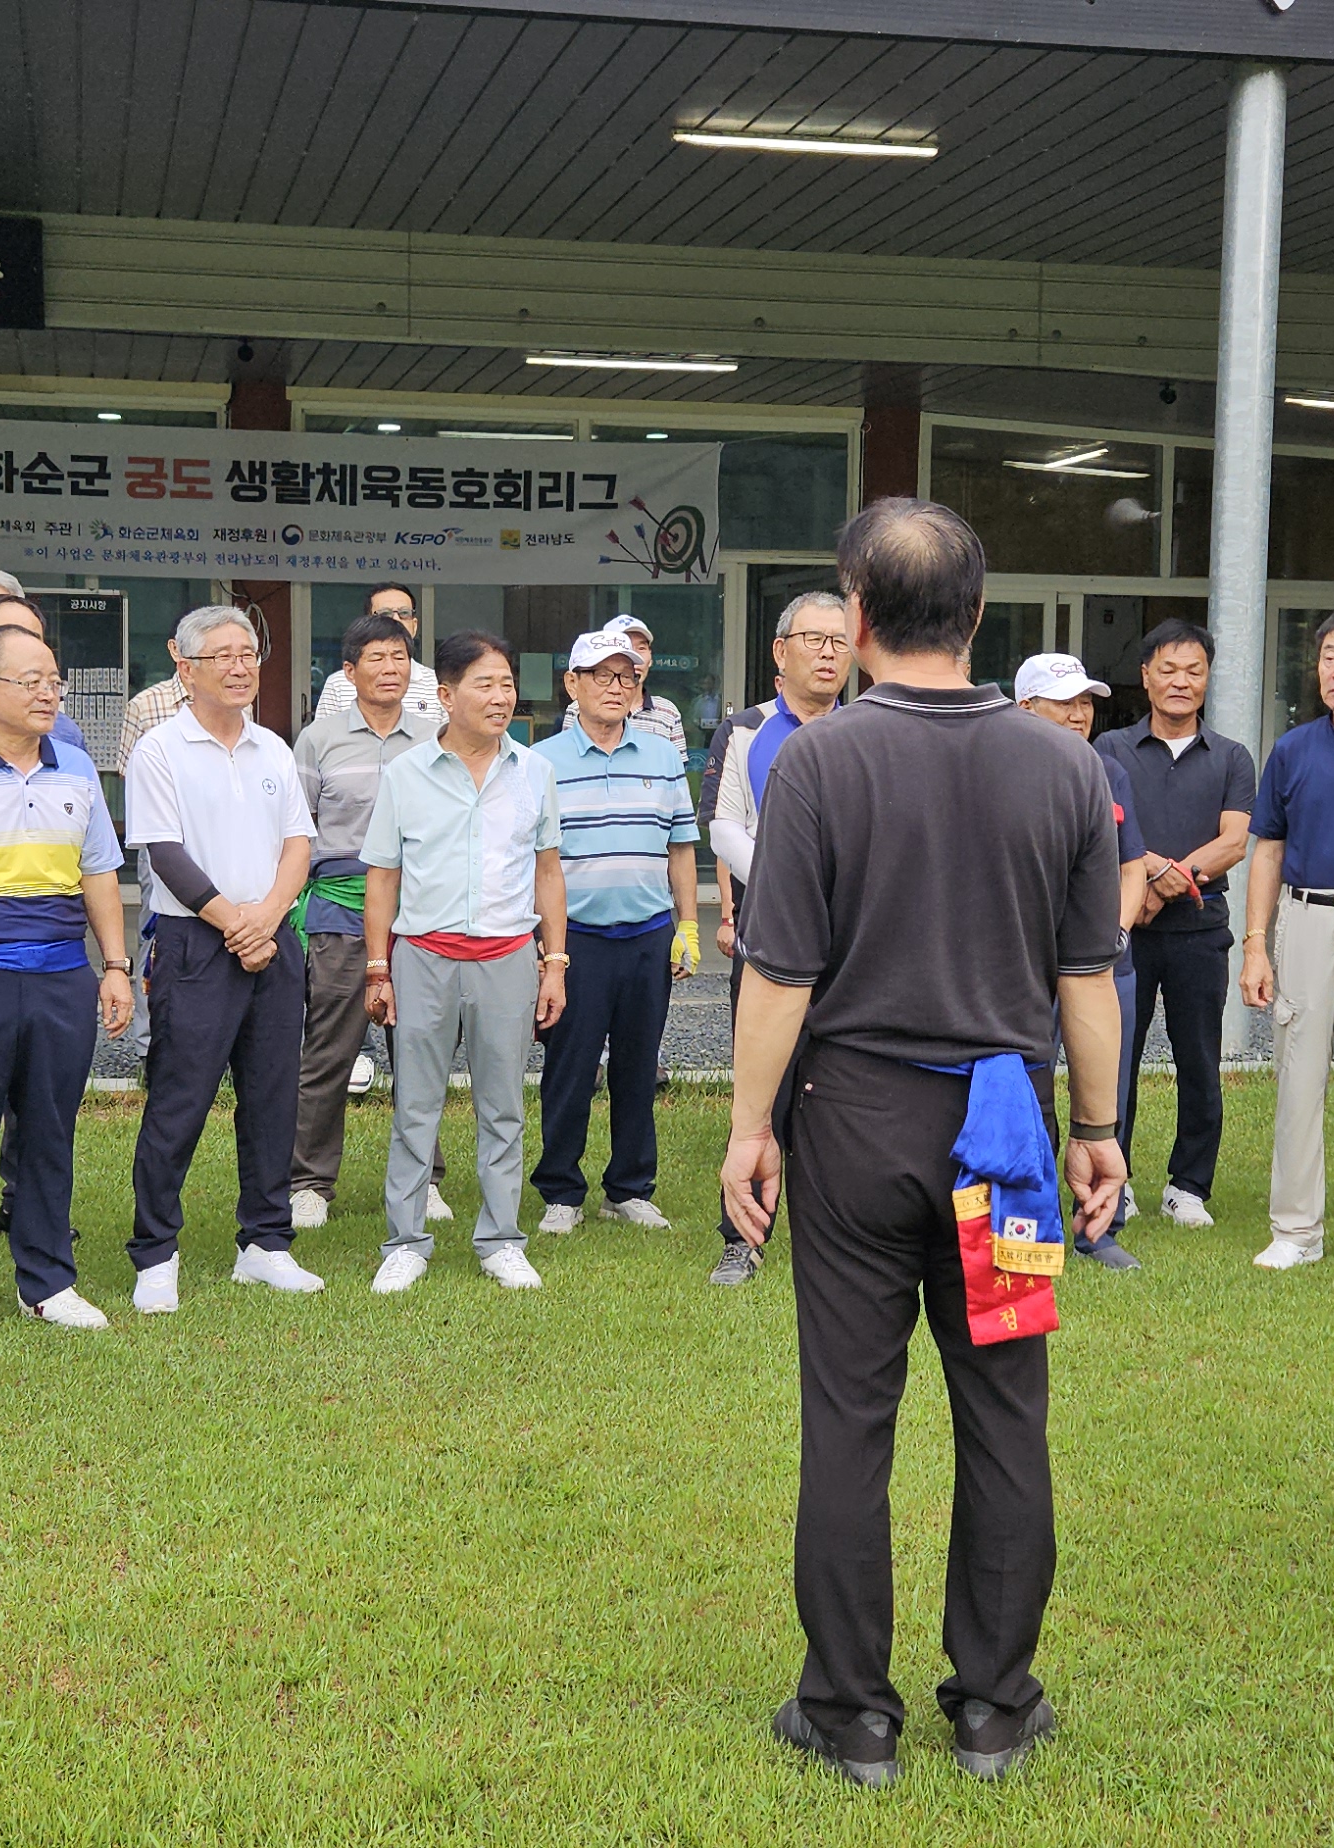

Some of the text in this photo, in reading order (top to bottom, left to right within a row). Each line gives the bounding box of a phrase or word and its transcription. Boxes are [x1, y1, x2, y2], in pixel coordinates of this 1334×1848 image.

[124, 457, 214, 500] 궁도
[224, 460, 618, 512] 생활체육동호회리그
[44, 521, 72, 536] 주관
[118, 527, 200, 542] 화순군체육회
[213, 529, 268, 543] 재정후원
[308, 530, 388, 544] 문화체육관광부
[394, 532, 446, 546] KSPO
[524, 533, 576, 546] 전라남도
[56, 548, 96, 562] 사업은
[102, 549, 208, 566] 문화체육관광부와
[216, 552, 279, 568] 전라남도의
[285, 554, 349, 570] 재정후원을
[356, 556, 381, 570] 받고
[387, 557, 442, 572] 있습니다.
[70, 599, 107, 611] 공지사항
